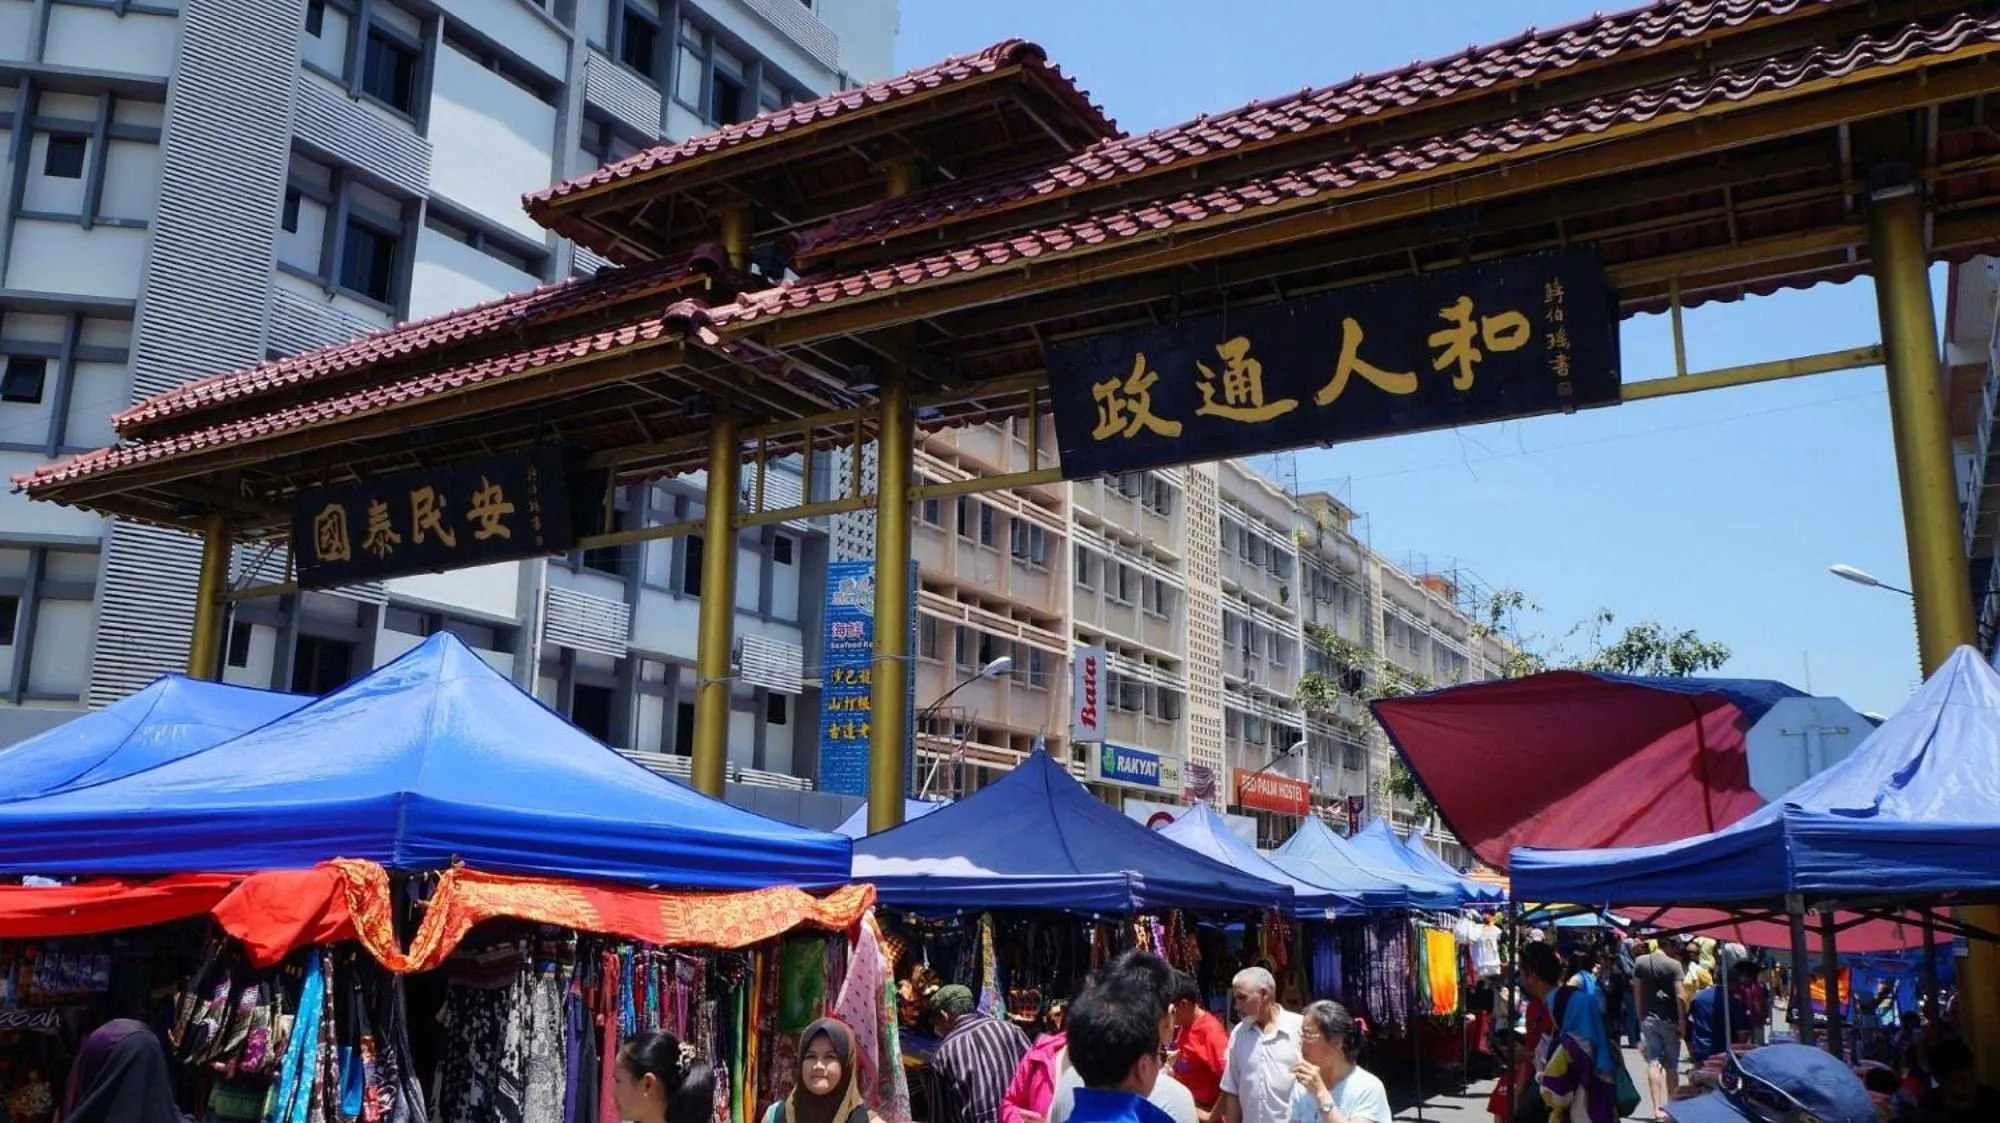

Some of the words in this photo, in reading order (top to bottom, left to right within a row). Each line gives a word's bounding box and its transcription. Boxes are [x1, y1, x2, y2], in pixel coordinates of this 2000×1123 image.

[1092, 296, 1531, 441] 政通人和
[315, 476, 514, 561] 國泰民安
[1080, 656, 1097, 731] Bata
[1117, 756, 1157, 777] RAKYAT
[1257, 778, 1278, 795] PALM
[1278, 782, 1303, 801] HOSTEL
